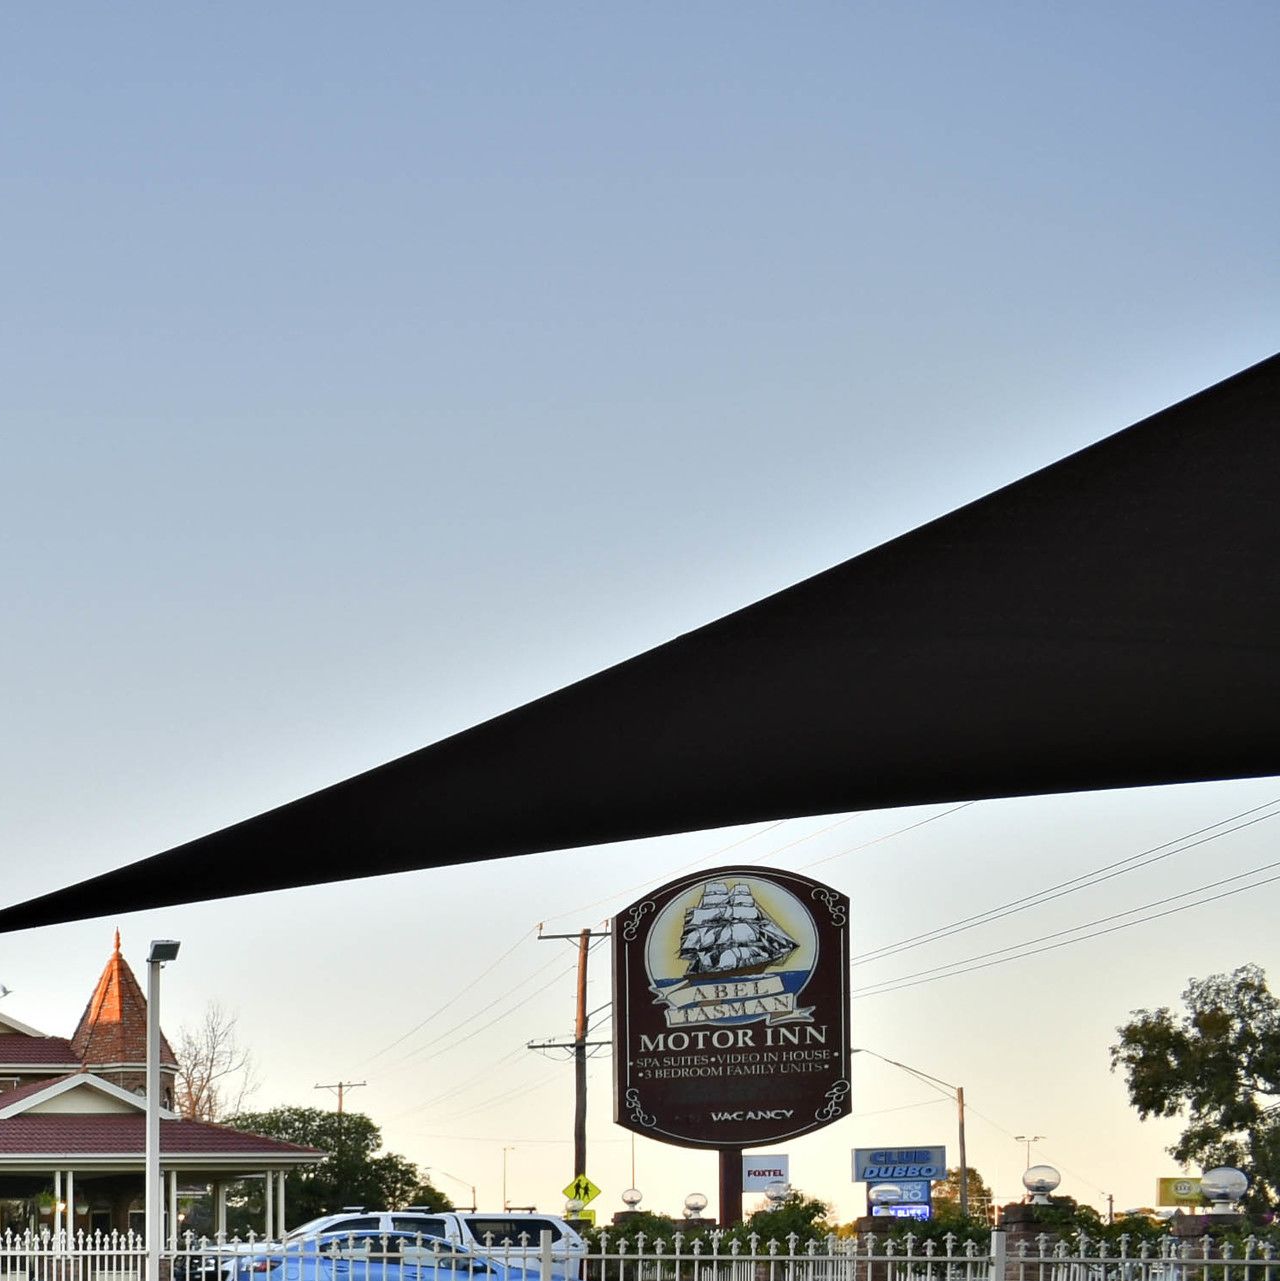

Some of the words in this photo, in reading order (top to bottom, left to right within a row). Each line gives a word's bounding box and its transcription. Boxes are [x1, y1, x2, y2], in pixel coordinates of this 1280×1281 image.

[693, 982, 769, 1002] ABEL
[678, 996, 790, 1022] TASMAN
[640, 1029, 755, 1052] MOTOR
[765, 1025, 828, 1046] INN
[637, 1057, 659, 1068] SPA
[663, 1055, 709, 1067] SUITES
[717, 1053, 759, 1065] VIDEO
[763, 1052, 779, 1062] IN
[782, 1050, 831, 1061] HOUSE
[655, 1066, 723, 1079] BEDROOM
[726, 1064, 776, 1076] FAMILY
[780, 1062, 824, 1074] UNITS
[711, 1110, 793, 1122] VACANCY
[869, 1150, 931, 1165] CLUB
[747, 1169, 784, 1177] FOXTEL
[863, 1166, 937, 1179] DUBBO
